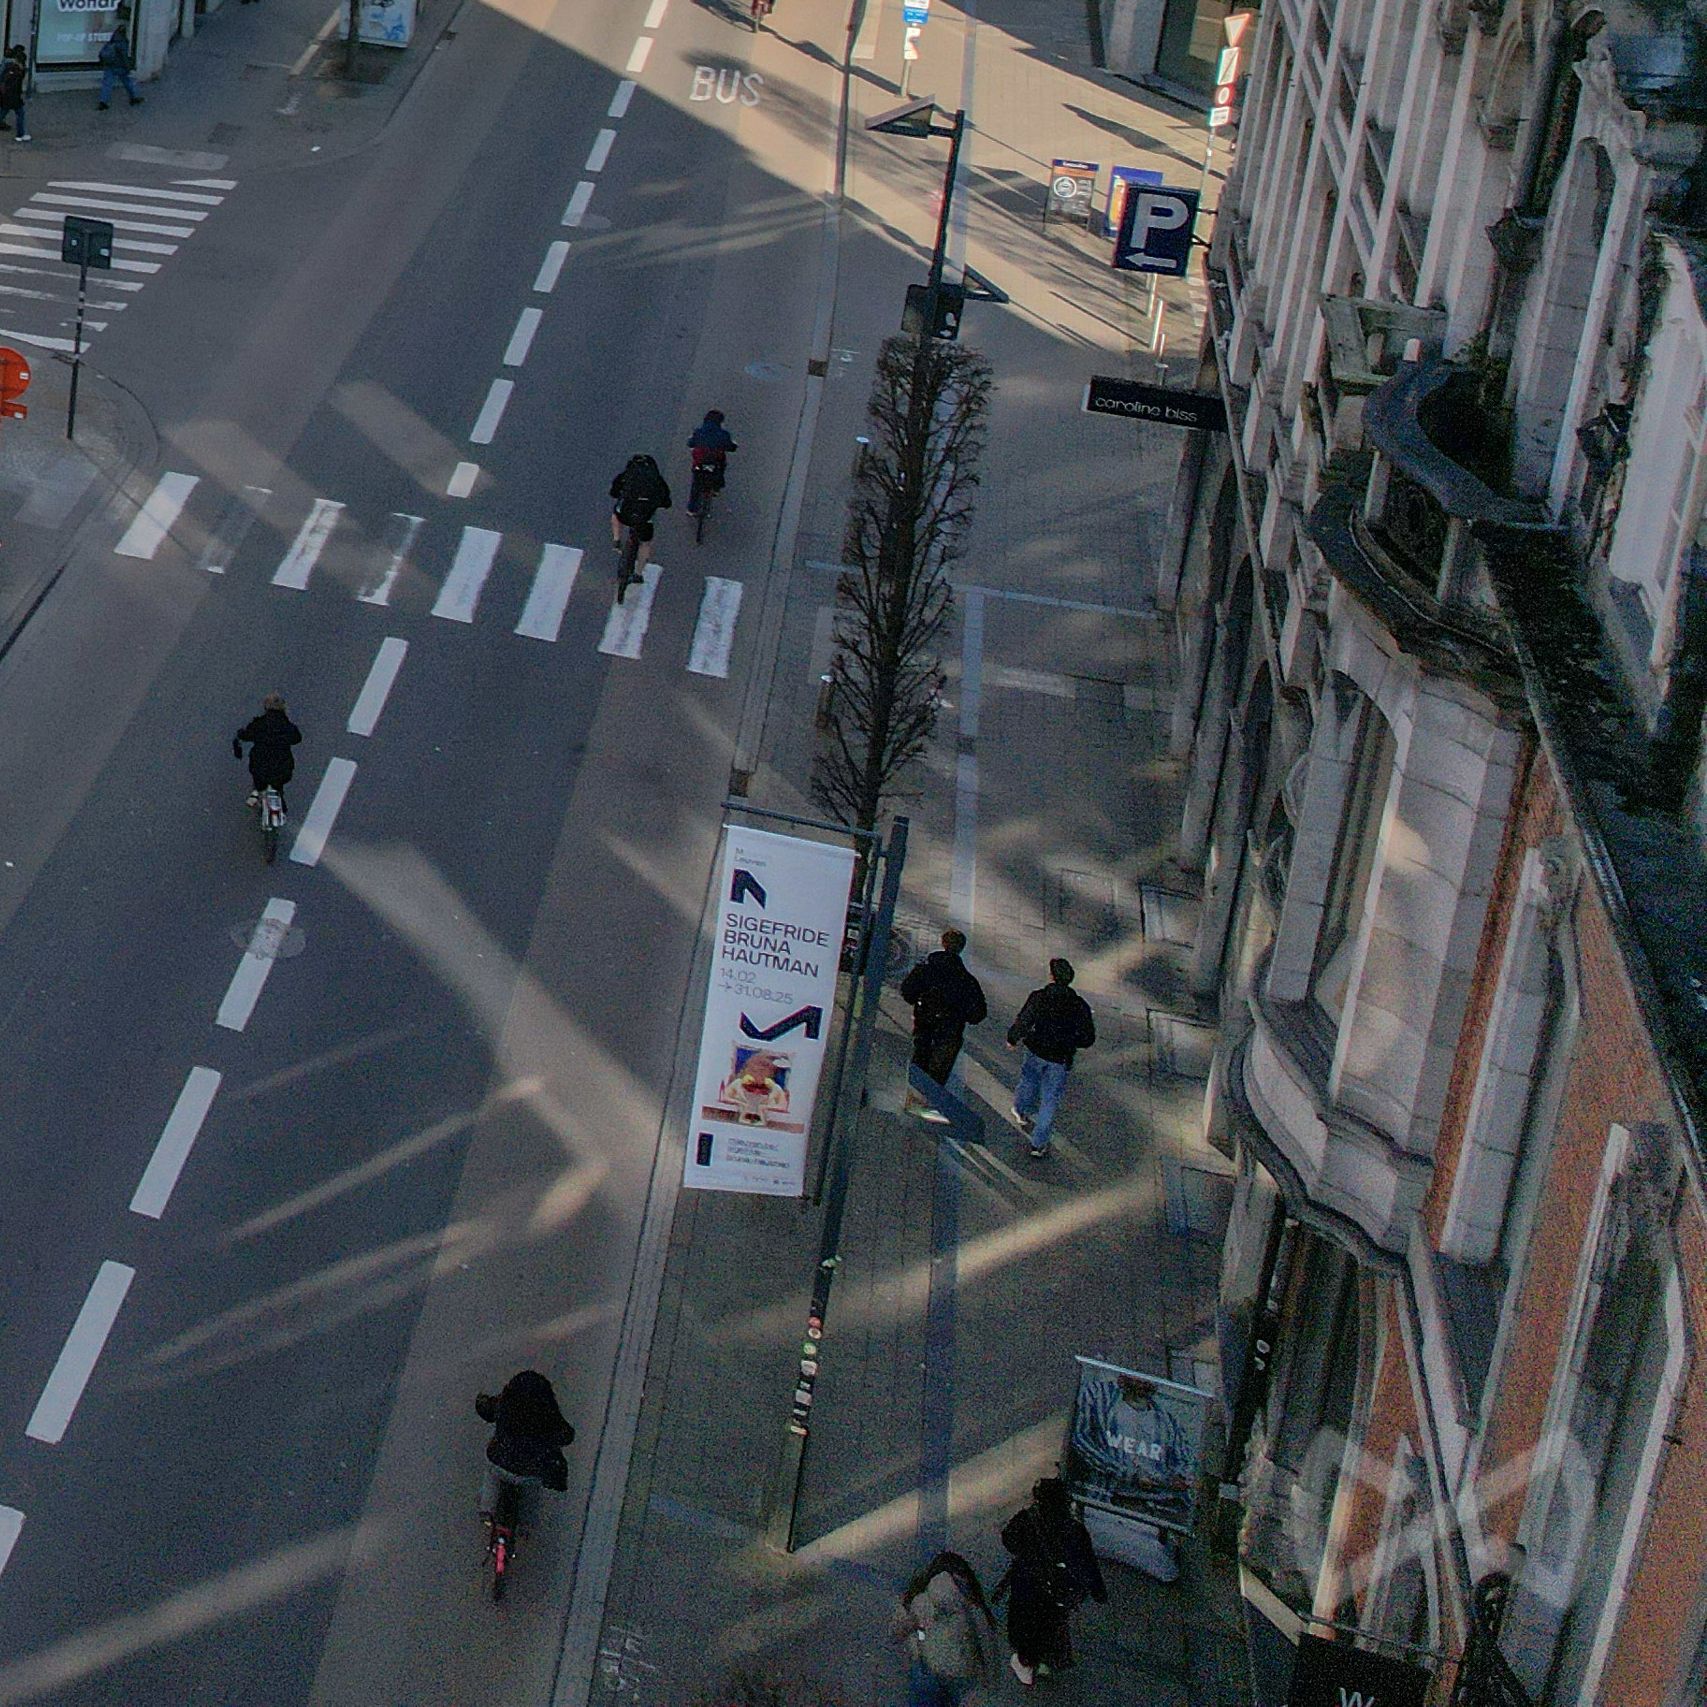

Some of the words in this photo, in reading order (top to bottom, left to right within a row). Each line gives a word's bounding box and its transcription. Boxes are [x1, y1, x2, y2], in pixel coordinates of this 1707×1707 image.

[690, 66, 764, 107] BUS
[1130, 193, 1189, 249] P
[1095, 397, 1161, 416] caroline
[723, 929, 791, 956] BRUNA
[726, 913, 831, 948] SIGEFRIDE
[719, 967, 756, 984] 14.02
[721, 945, 819, 978] HAUTMAN
[1106, 1430, 1162, 1461] WEAR
